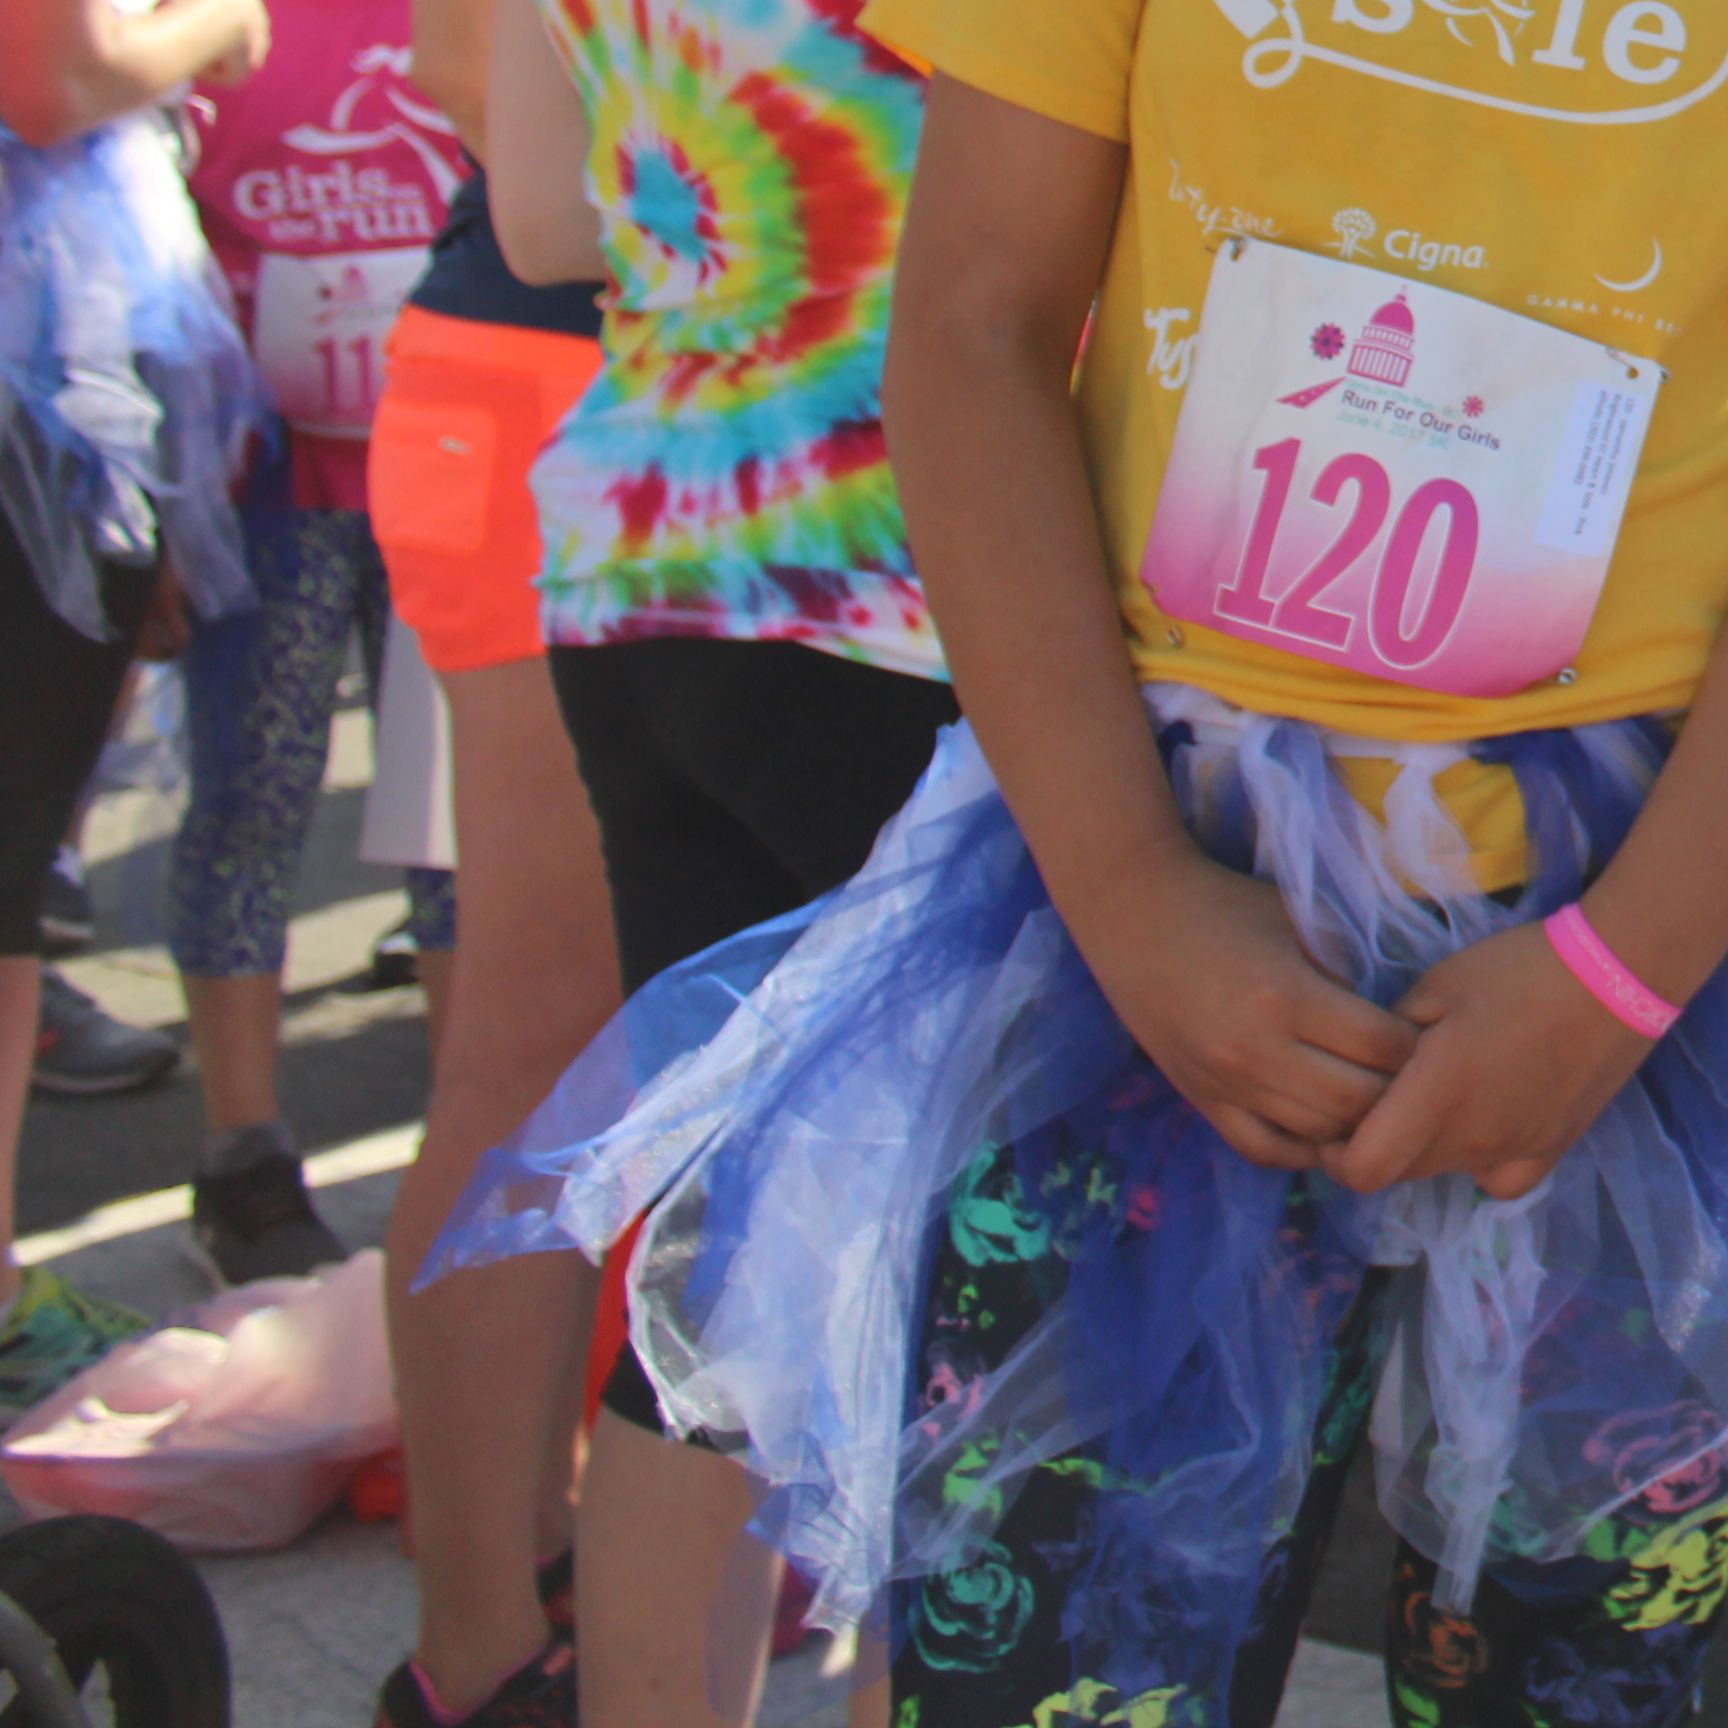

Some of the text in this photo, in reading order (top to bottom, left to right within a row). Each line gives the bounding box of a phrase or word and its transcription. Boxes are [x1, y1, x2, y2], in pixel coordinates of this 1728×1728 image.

[234, 161, 390, 219] Girls
[319, 202, 434, 243] run
[1383, 229, 1486, 271] Cigna
[313, 334, 374, 414] 11
[1342, 389, 1378, 412] Run
[1382, 399, 1415, 422] For
[1419, 411, 1454, 435] Our
[1457, 424, 1501, 451] Girls
[1213, 435, 1480, 671] 120
